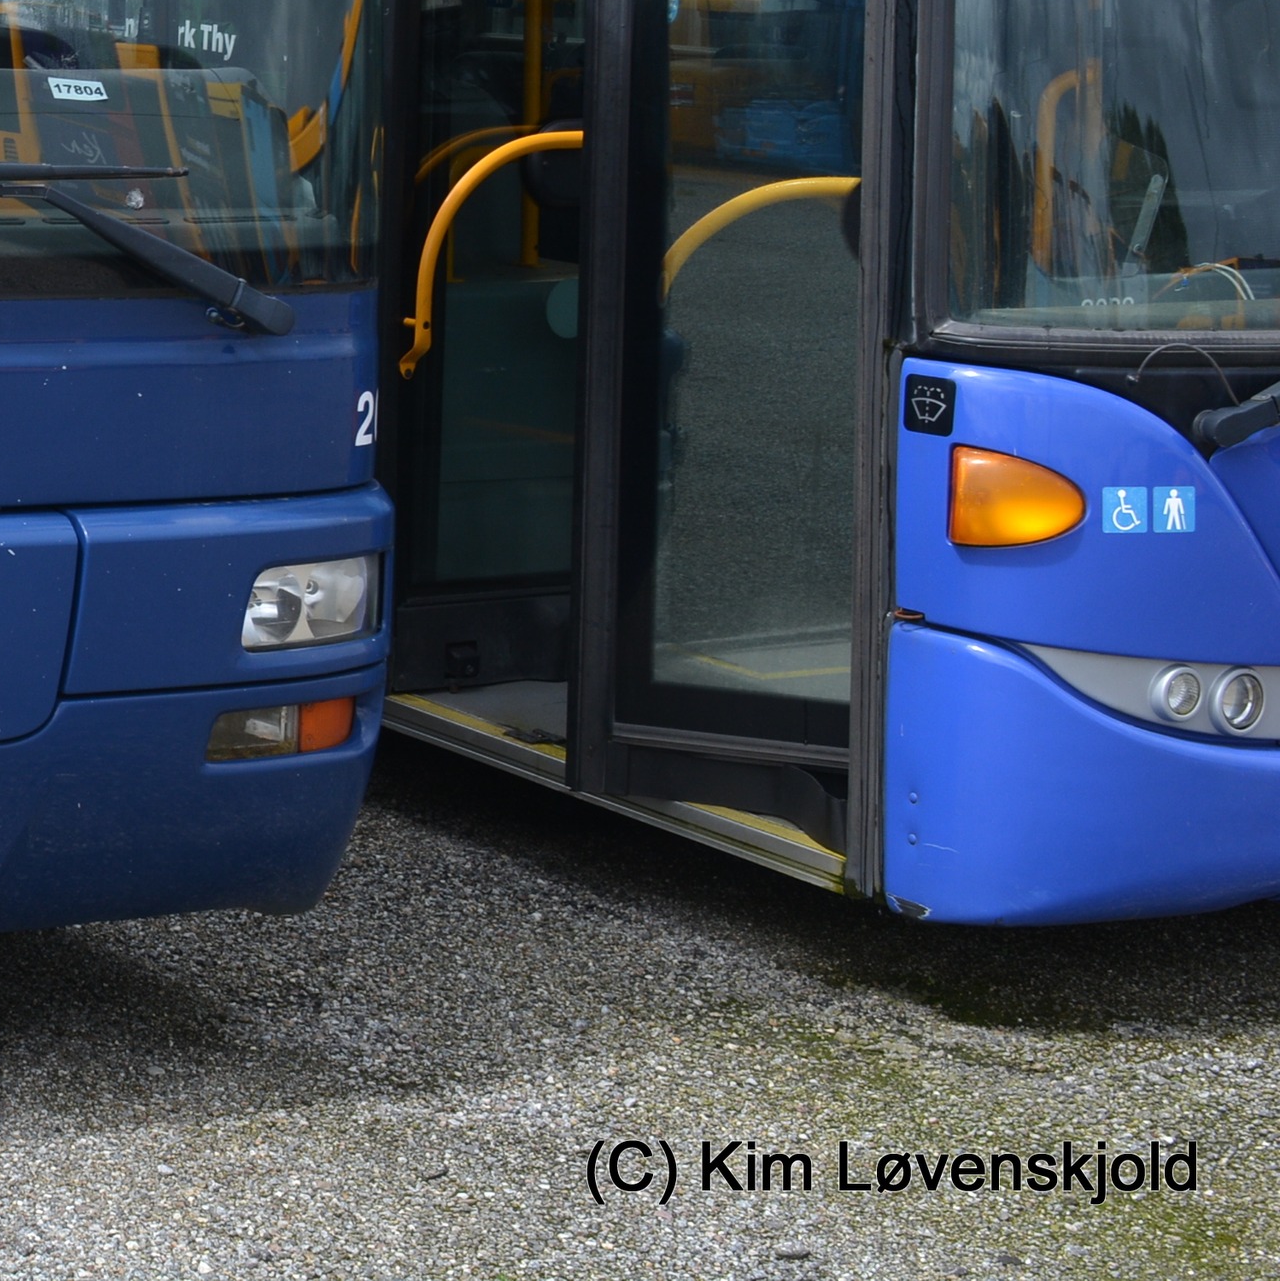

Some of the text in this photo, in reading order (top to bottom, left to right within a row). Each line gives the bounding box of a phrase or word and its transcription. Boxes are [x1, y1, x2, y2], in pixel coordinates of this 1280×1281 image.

[200, 24, 237, 61] Thy
[52, 83, 105, 98] 17804
[354, 390, 379, 447] 2
